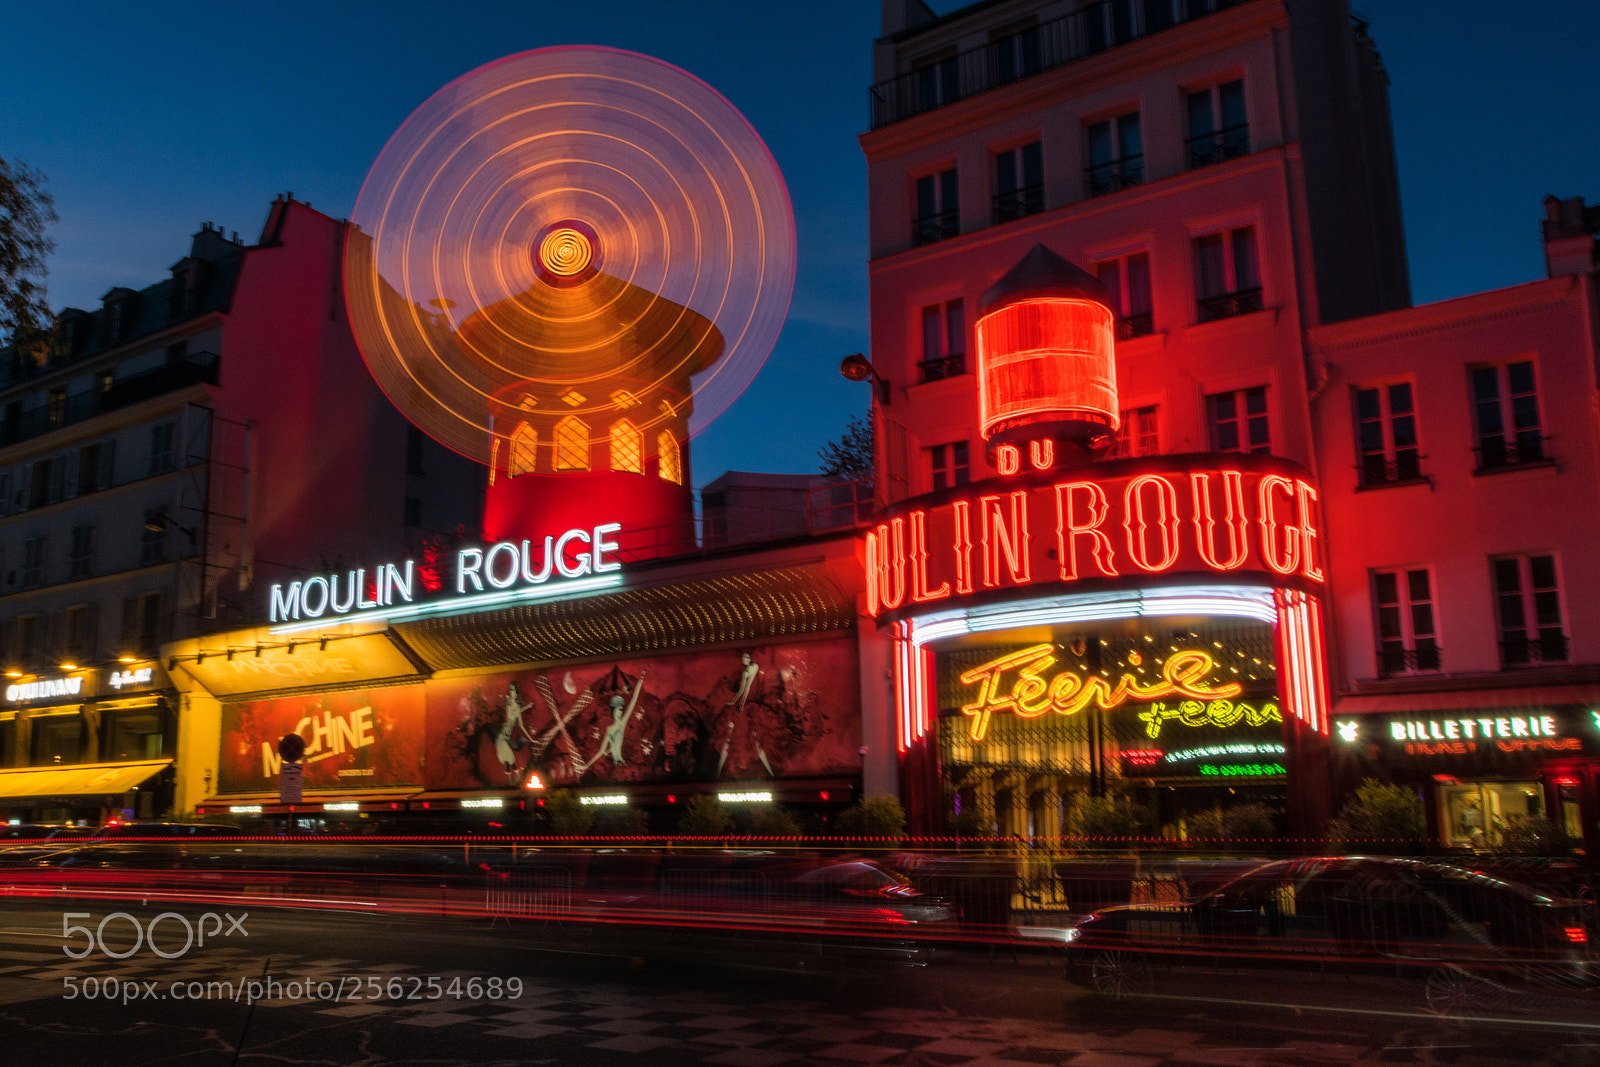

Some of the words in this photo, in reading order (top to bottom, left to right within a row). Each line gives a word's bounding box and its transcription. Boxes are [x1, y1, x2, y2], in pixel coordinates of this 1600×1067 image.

[997, 439, 1054, 475] DU
[1054, 470, 1324, 582] ROUGE
[270, 560, 414, 622] MOULIN
[457, 522, 621, 594] ROUGE
[262, 706, 375, 778] MCHINE
[1390, 716, 1557, 740] BILLETTERIE
